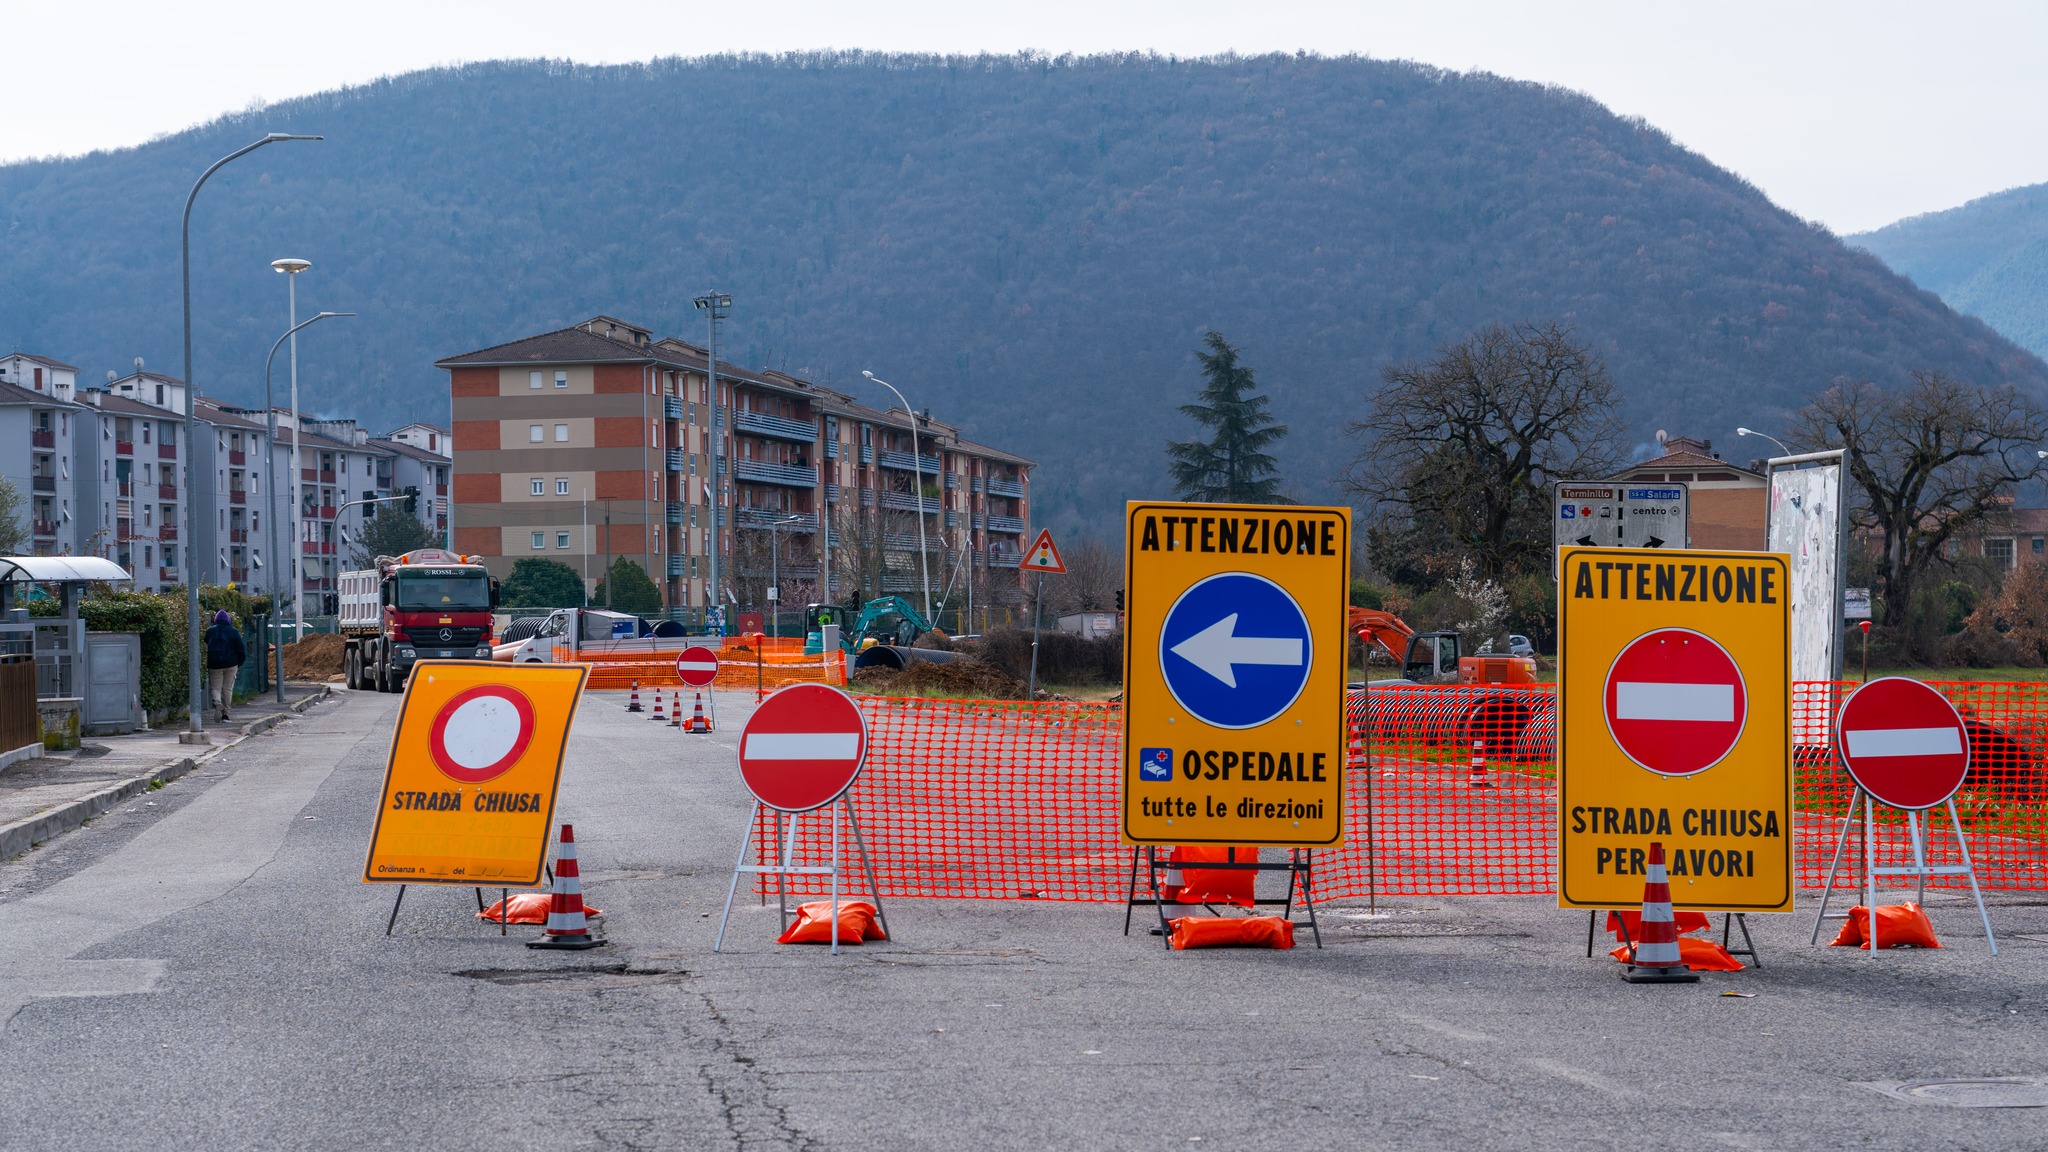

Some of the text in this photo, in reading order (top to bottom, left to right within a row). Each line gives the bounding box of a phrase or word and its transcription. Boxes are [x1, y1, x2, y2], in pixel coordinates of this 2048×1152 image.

[1565, 489, 1610, 498] Terminillo
[1647, 490, 1680, 499] Salaria
[1632, 507, 1667, 515] centro
[1141, 515, 1336, 556] ATTENZIONE
[1574, 561, 1777, 604] ATTENZIONE
[1182, 749, 1327, 783] OSPEDALE
[393, 791, 540, 813] STRADA CHIUSA
[1141, 795, 1324, 820] tutte le direzioni
[1571, 806, 1780, 838] STRADA CHIUSA
[378, 864, 416, 874] Ordinanza
[452, 867, 465, 875] del
[1597, 847, 1754, 877] PER AVORI
